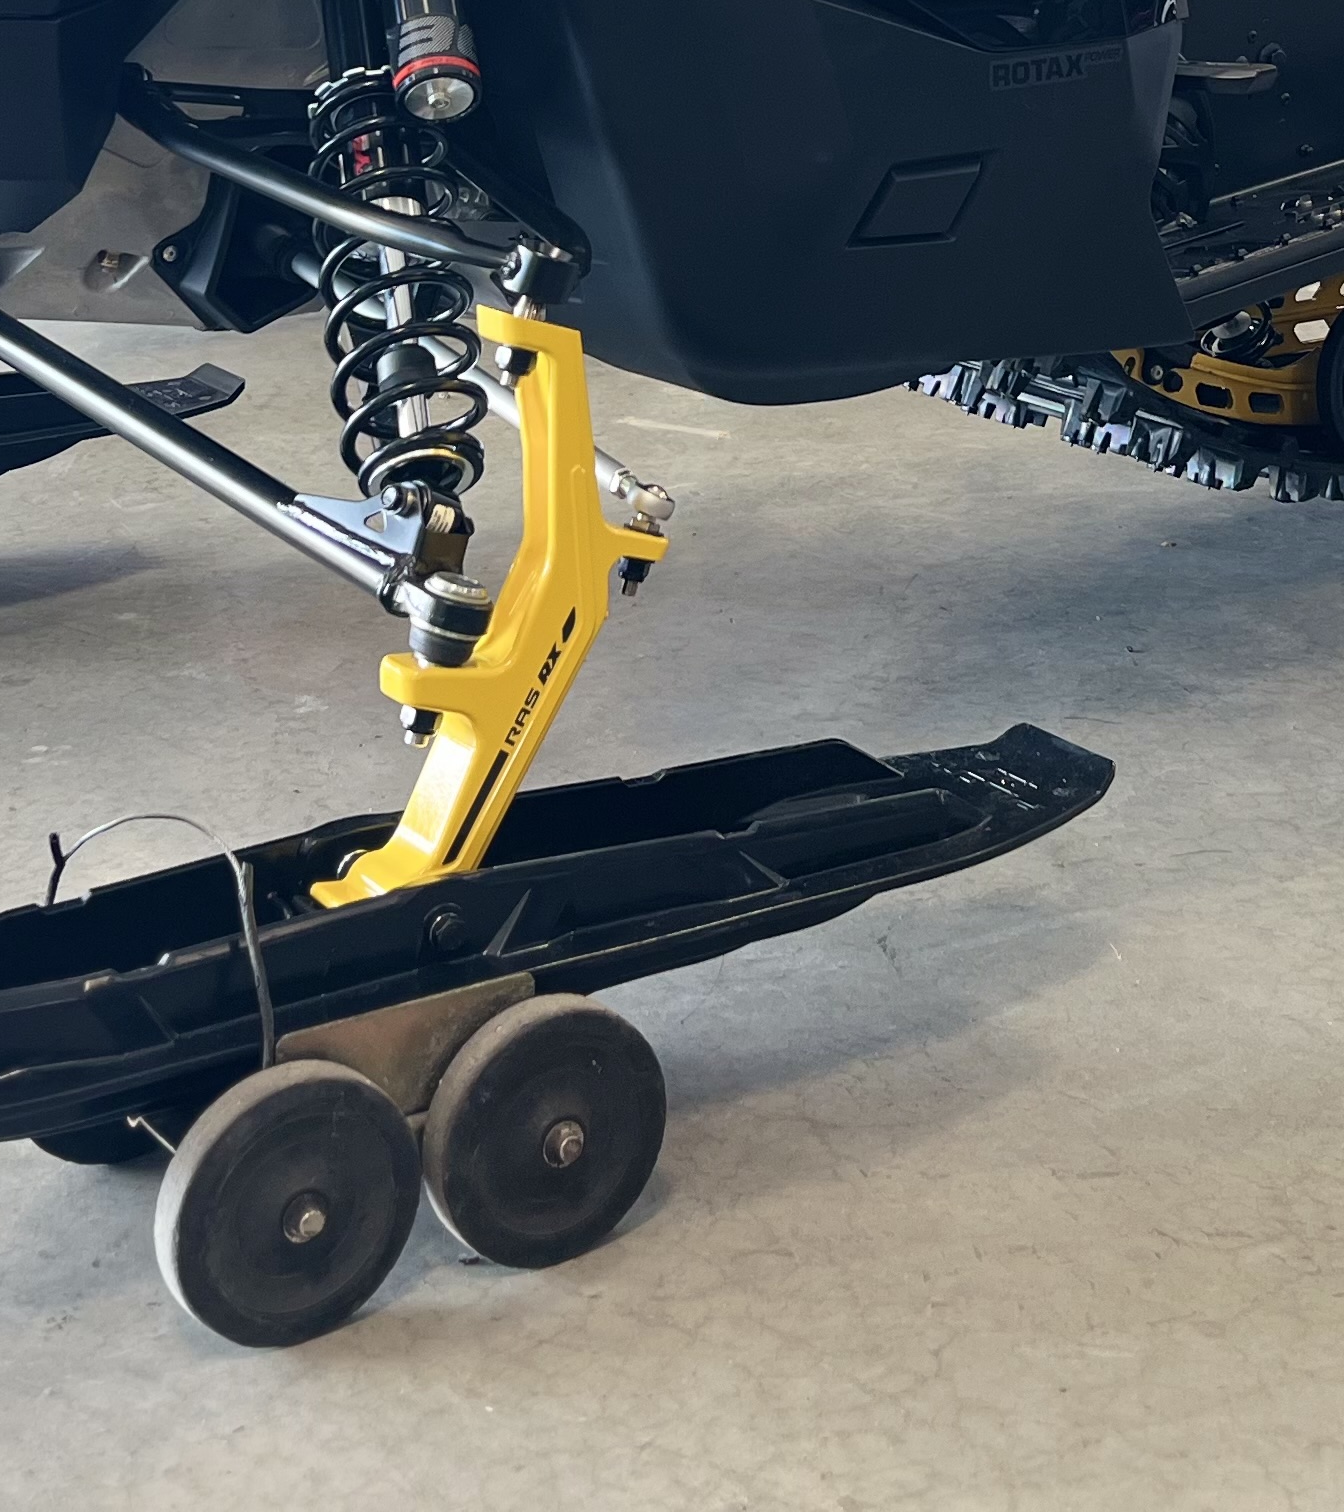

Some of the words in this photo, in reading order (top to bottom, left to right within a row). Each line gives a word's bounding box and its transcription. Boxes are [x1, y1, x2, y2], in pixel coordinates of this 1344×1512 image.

[991, 53, 1084, 88] ROTAX
[504, 687, 541, 747] RAS
[537, 640, 562, 686] RX
